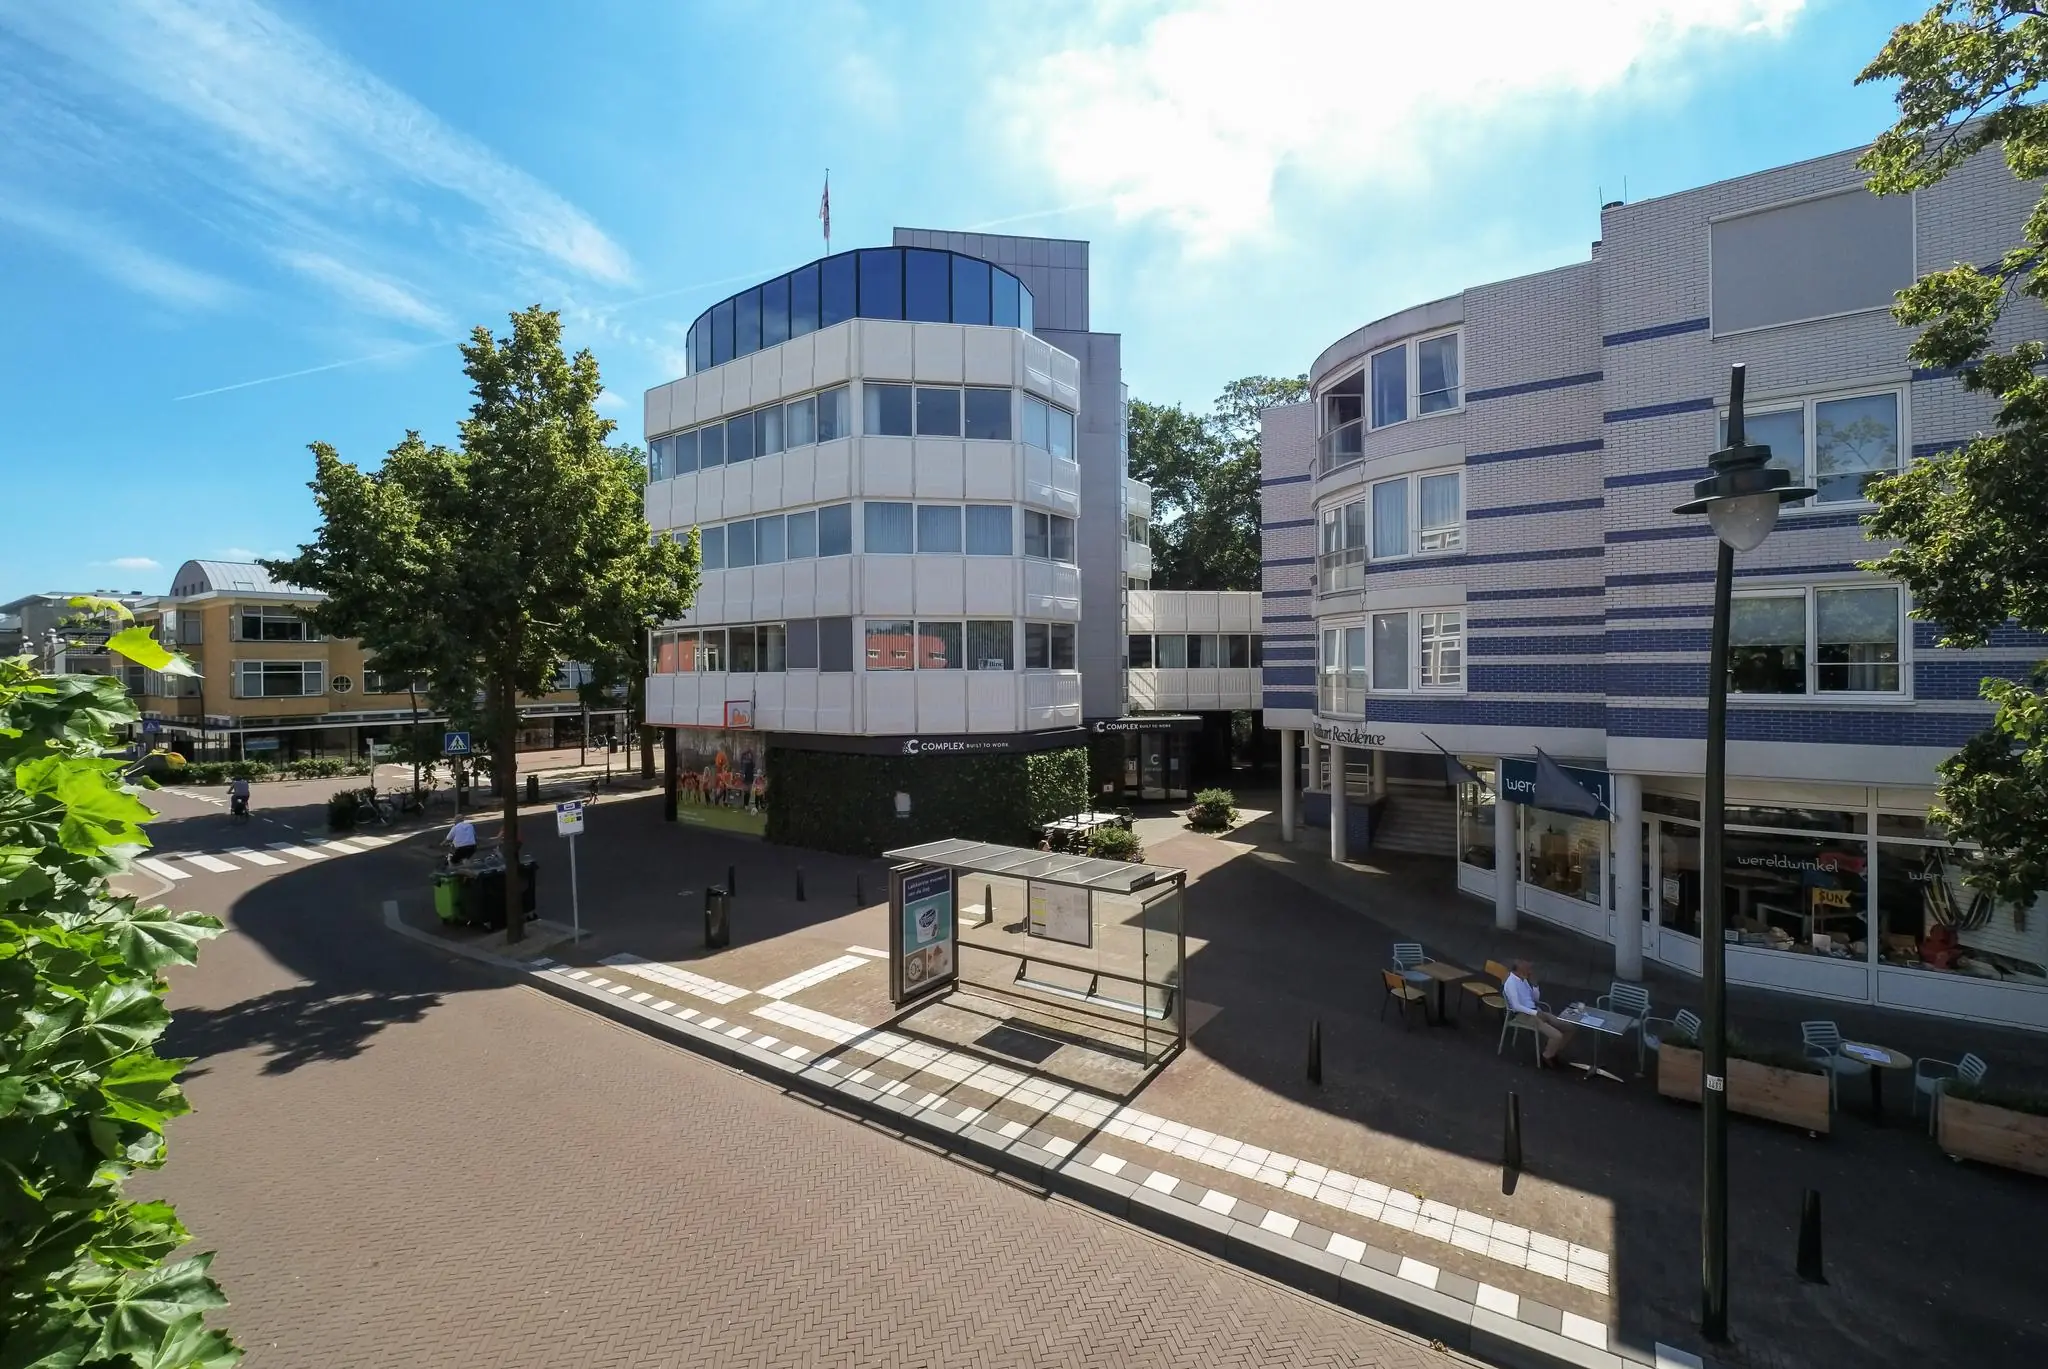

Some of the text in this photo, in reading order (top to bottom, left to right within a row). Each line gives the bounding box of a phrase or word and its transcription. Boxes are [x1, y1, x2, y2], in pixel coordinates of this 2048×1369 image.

[1332, 725, 1386, 746] Residence
[921, 742, 965, 751] COMPLEX
[1737, 854, 1839, 873] wereldwinkel
[1819, 891, 1844, 904] SUN
